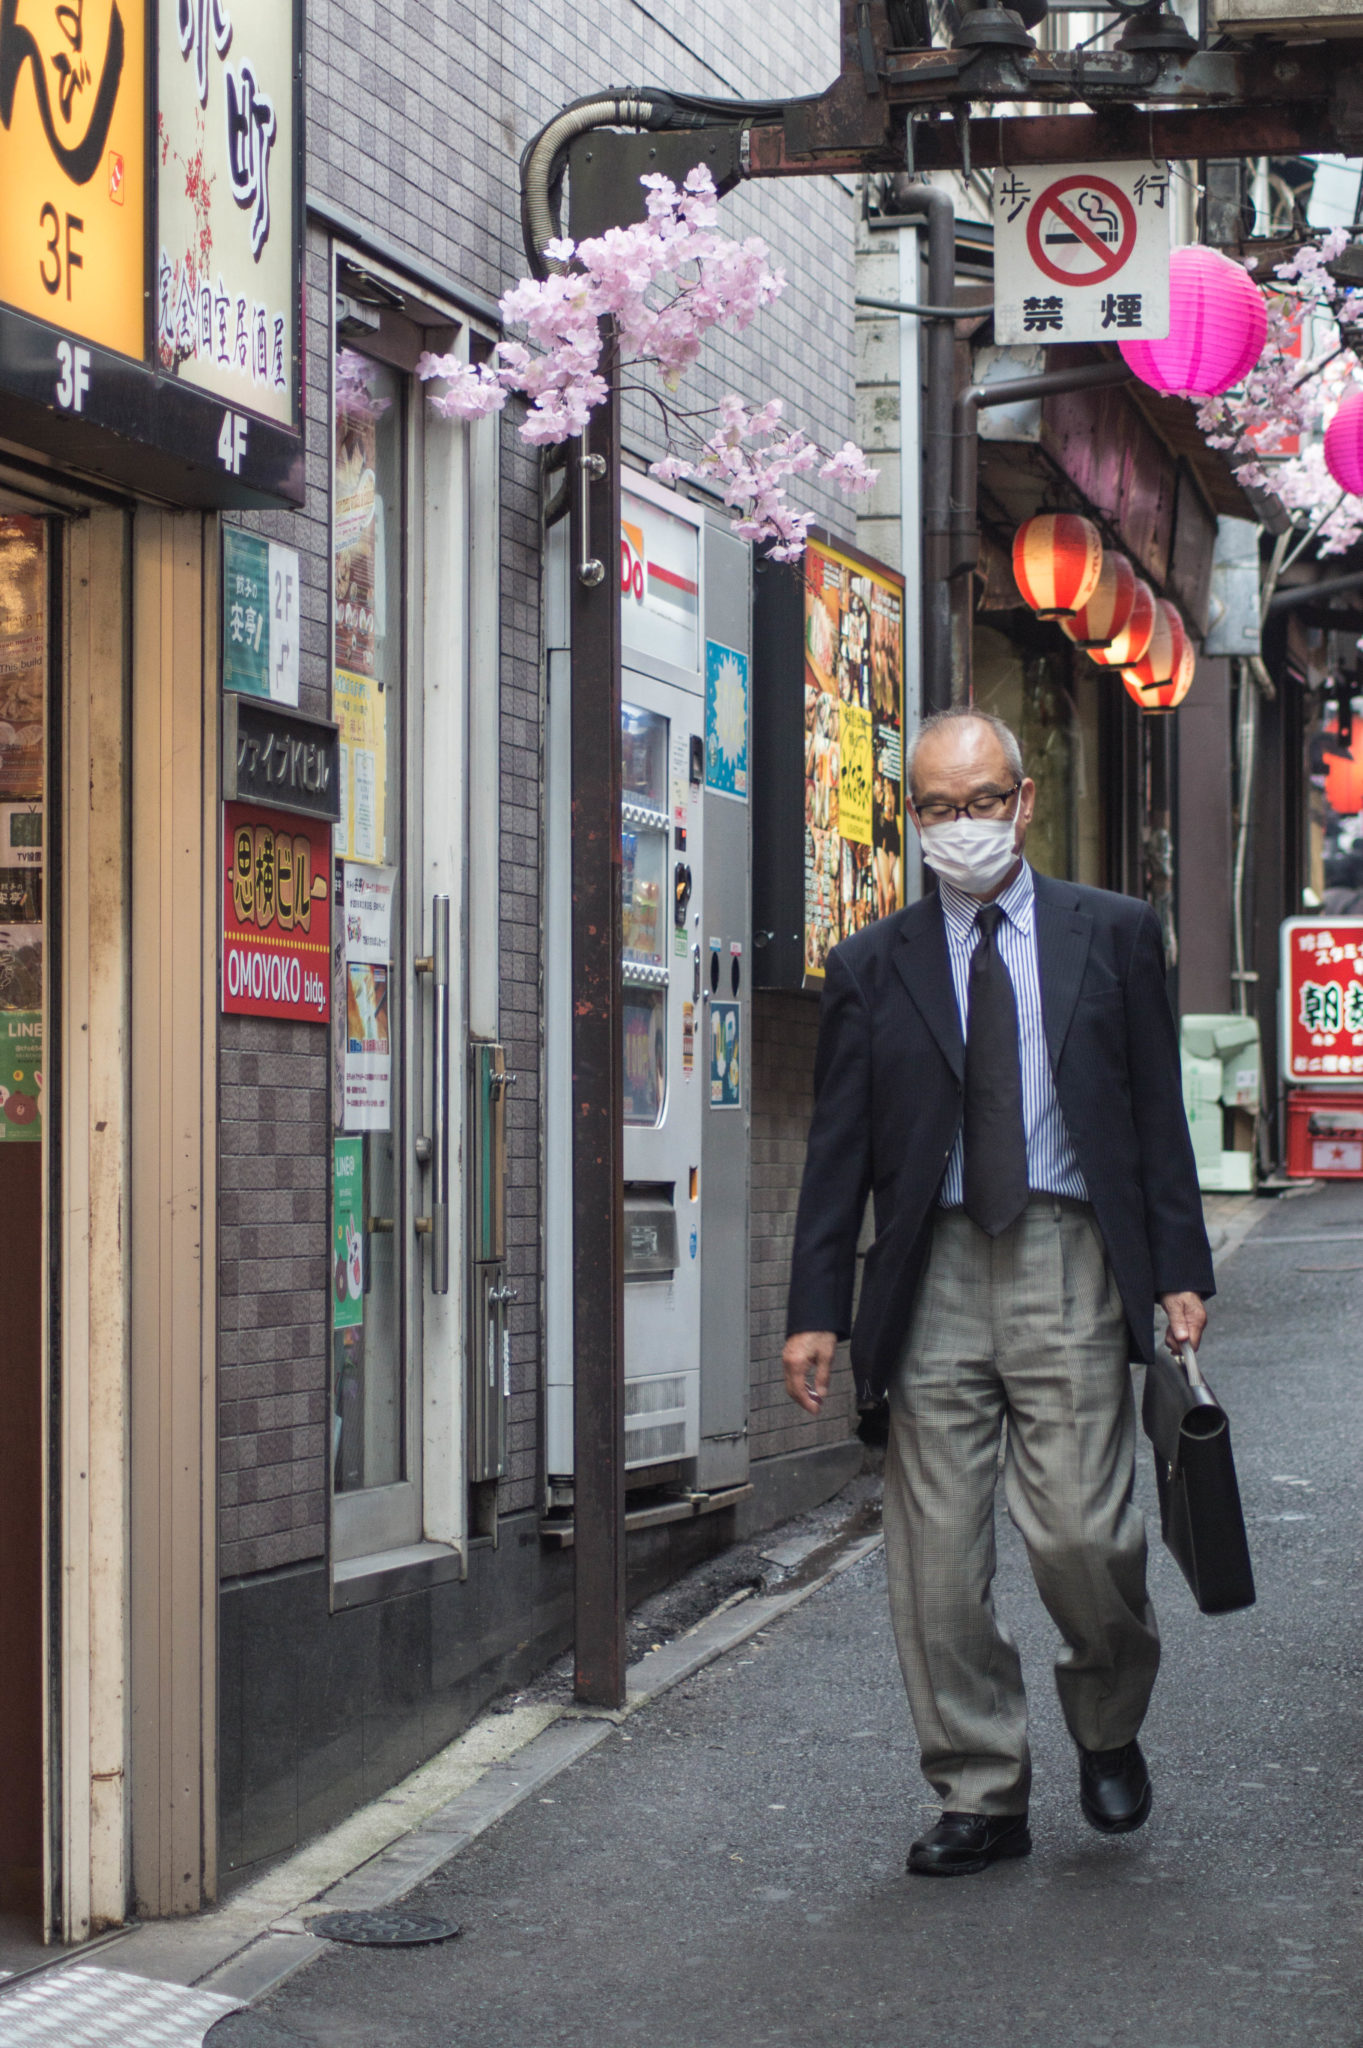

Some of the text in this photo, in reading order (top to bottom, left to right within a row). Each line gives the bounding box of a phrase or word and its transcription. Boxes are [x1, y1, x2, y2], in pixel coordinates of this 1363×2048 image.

[39, 202, 84, 302] 3F
[159, 252, 285, 386] 完全個室居酒屋
[56, 341, 91, 412] 3F
[217, 411, 248, 475] 4F
[235, 574, 258, 600] 餃子の
[274, 570, 293, 623] 2F
[228, 948, 326, 1013] OMOYOKO bldg.
[8, 1022, 42, 1038] LINE
